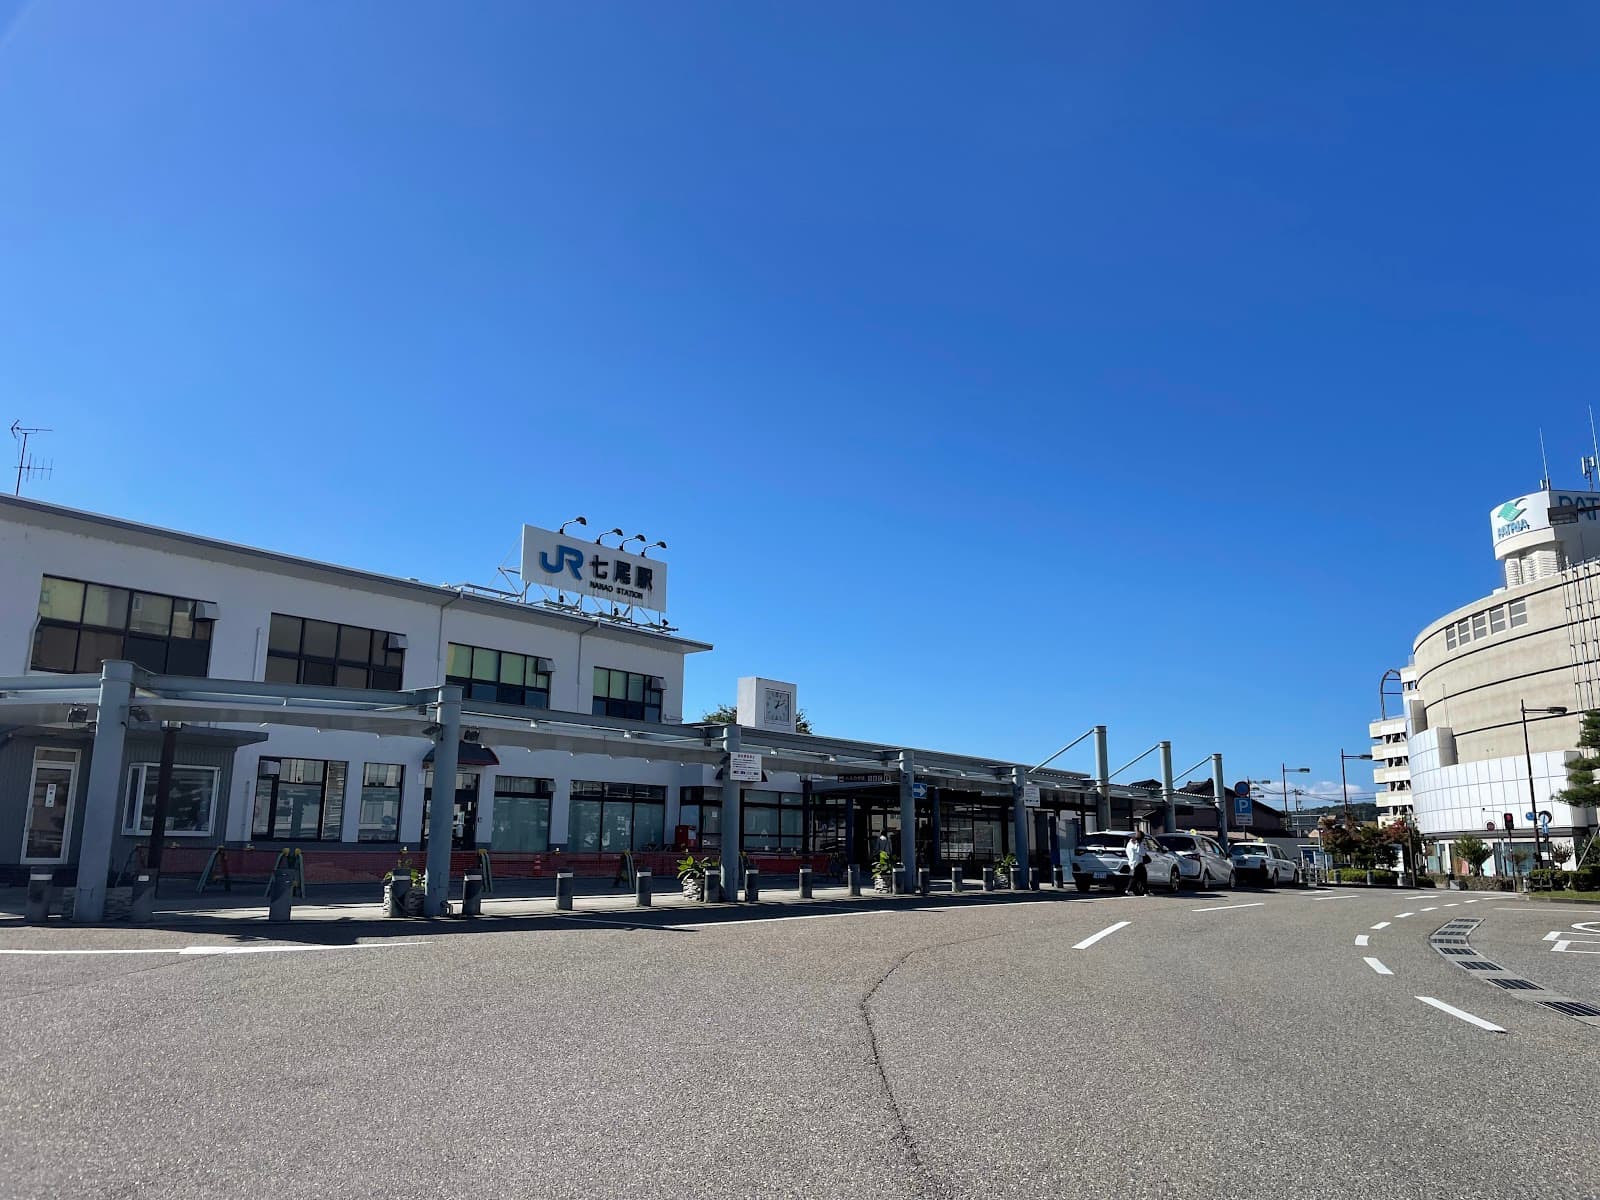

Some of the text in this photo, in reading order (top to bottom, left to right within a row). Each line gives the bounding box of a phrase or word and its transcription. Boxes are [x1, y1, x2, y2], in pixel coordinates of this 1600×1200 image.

[539, 544, 653, 591] JR 七尾駅
[590, 580, 643, 600] NANAO STATION
[1239, 800, 1249, 813] P
